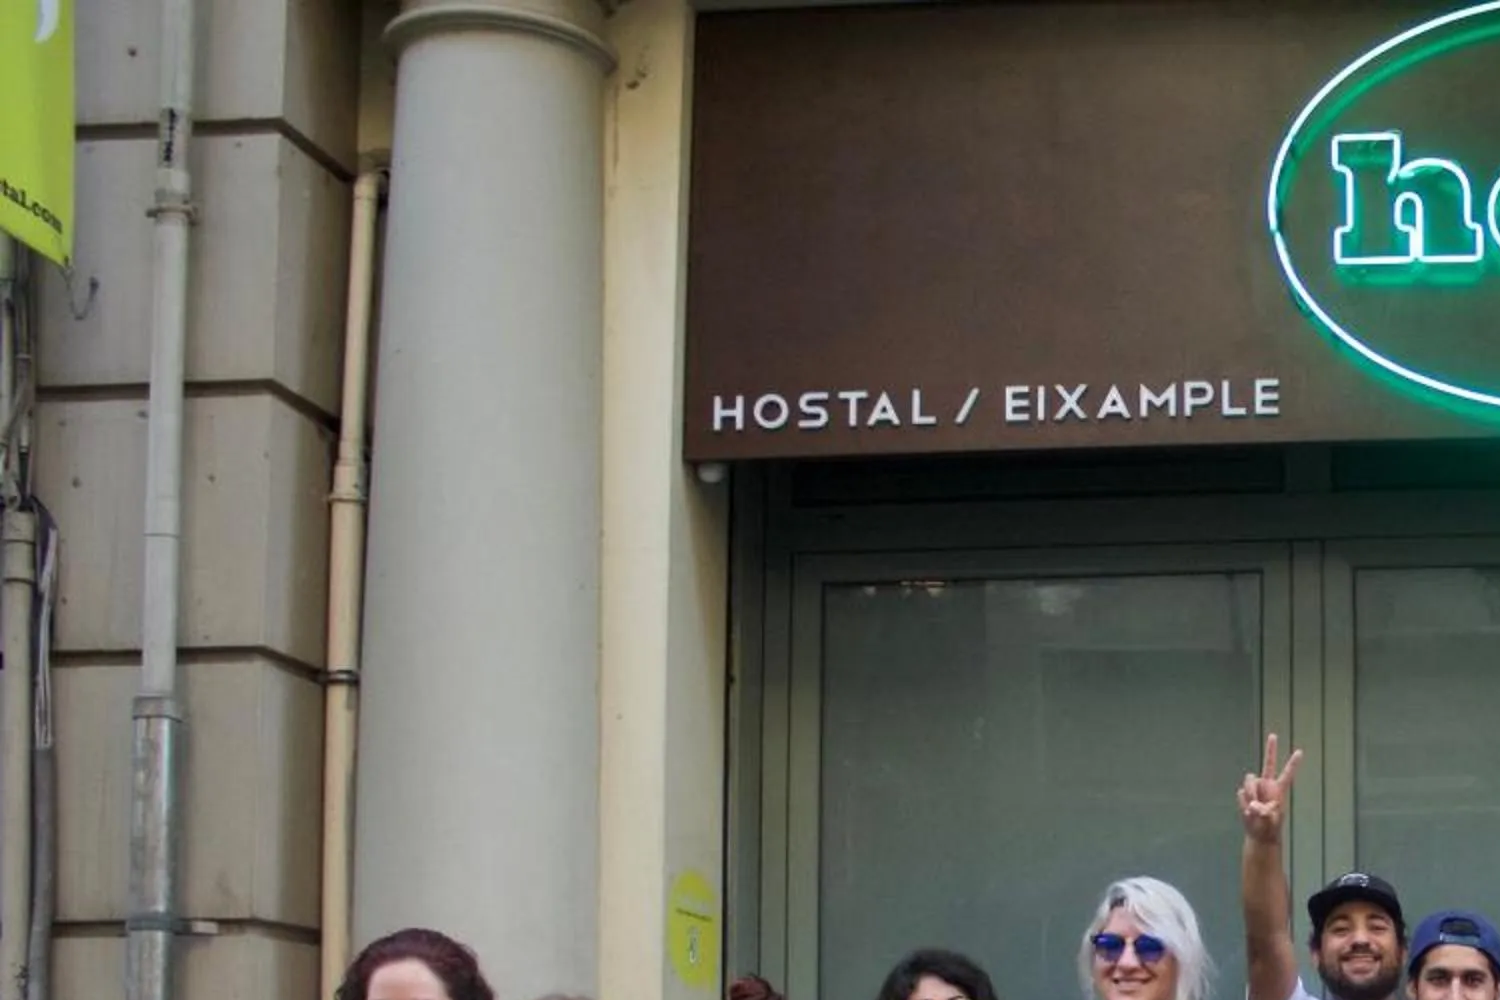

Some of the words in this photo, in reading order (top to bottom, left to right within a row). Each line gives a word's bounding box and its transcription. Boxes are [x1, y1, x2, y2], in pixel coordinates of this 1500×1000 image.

[0, 178, 63, 234] tal.com
[713, 388, 937, 431] HOSTAL
[1004, 378, 1281, 423] EIXAMPLE
